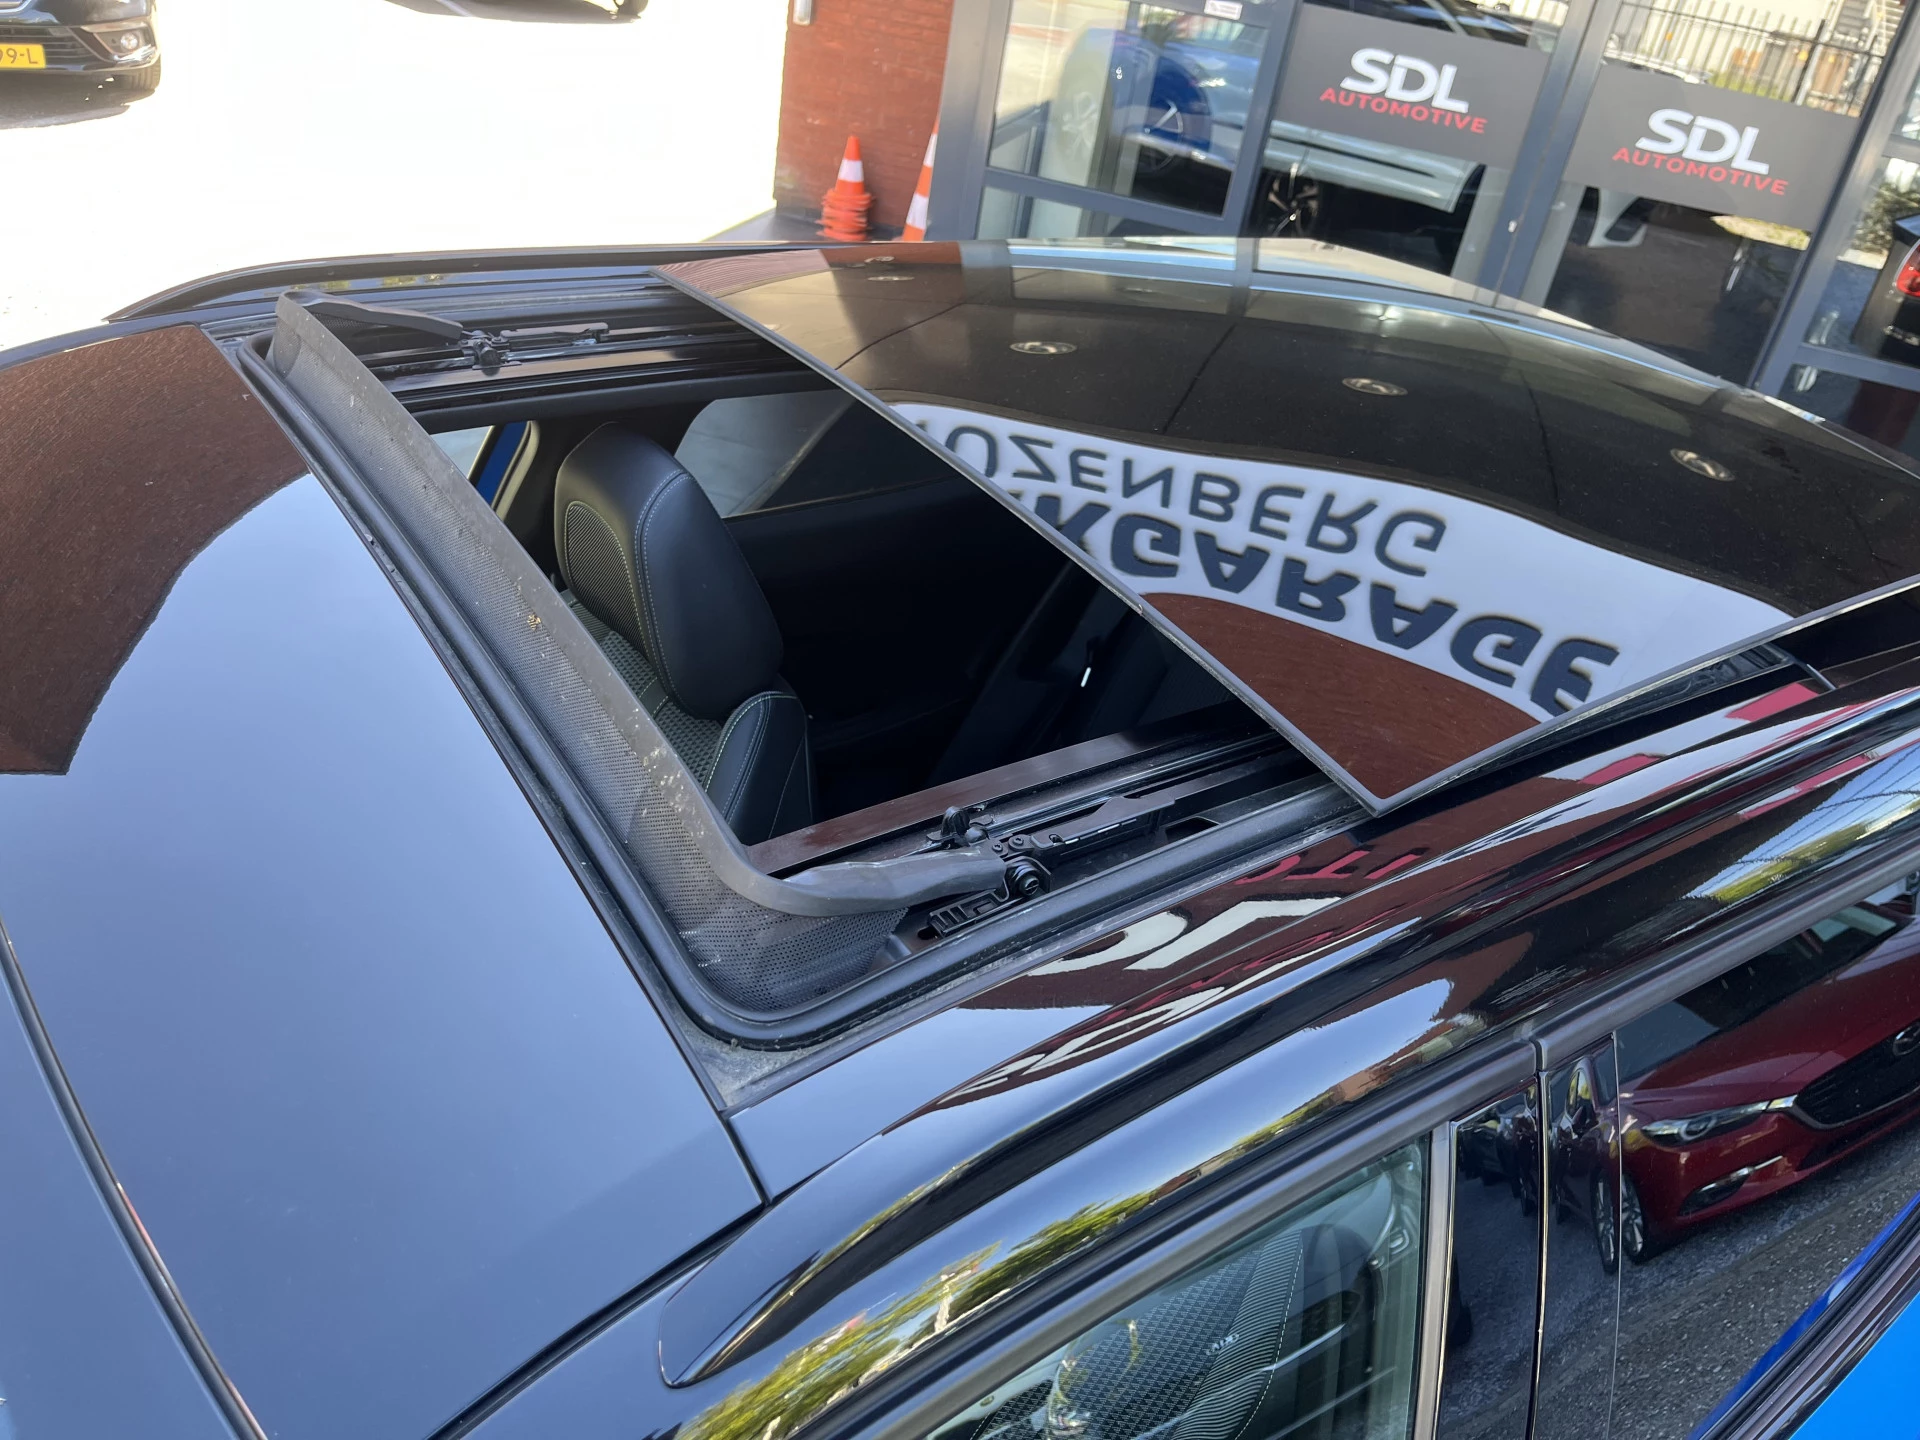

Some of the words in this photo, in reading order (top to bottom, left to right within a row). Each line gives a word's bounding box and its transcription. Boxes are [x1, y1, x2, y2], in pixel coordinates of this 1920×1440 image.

[1340, 47, 1469, 114] SDL
[1319, 87, 1488, 134] AUTOMOTIVE
[1635, 108, 1770, 175] SDL
[1612, 146, 1789, 196] AUTOMOTIVE
